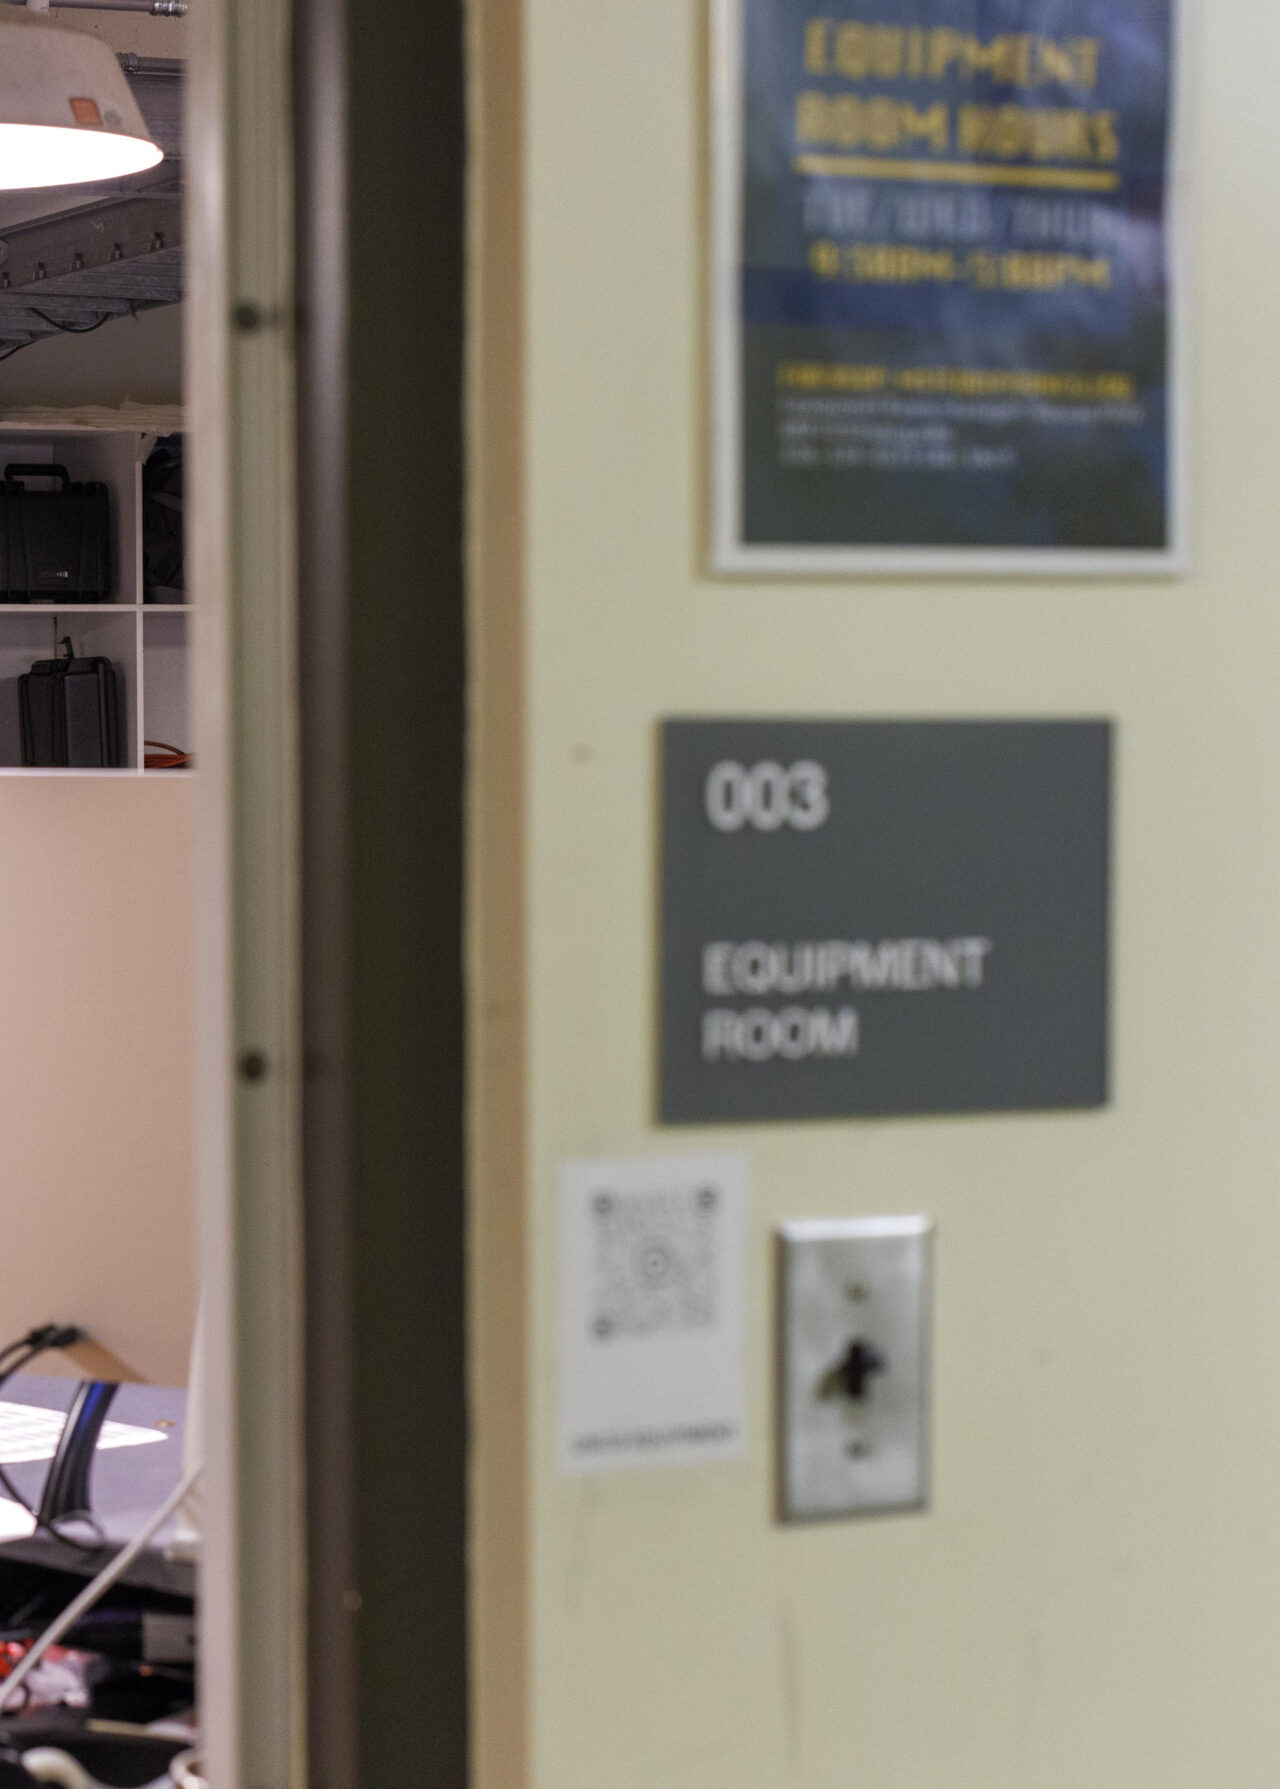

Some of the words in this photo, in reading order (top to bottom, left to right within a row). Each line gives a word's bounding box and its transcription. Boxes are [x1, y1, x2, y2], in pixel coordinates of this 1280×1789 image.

[805, 18, 1099, 91] EQUIPMENT
[796, 91, 948, 154] ROOM
[958, 103, 1117, 163] HOURS
[706, 760, 829, 832] 003
[702, 937, 993, 996] EQUIPMENT
[702, 1004, 859, 1062] ROOM
